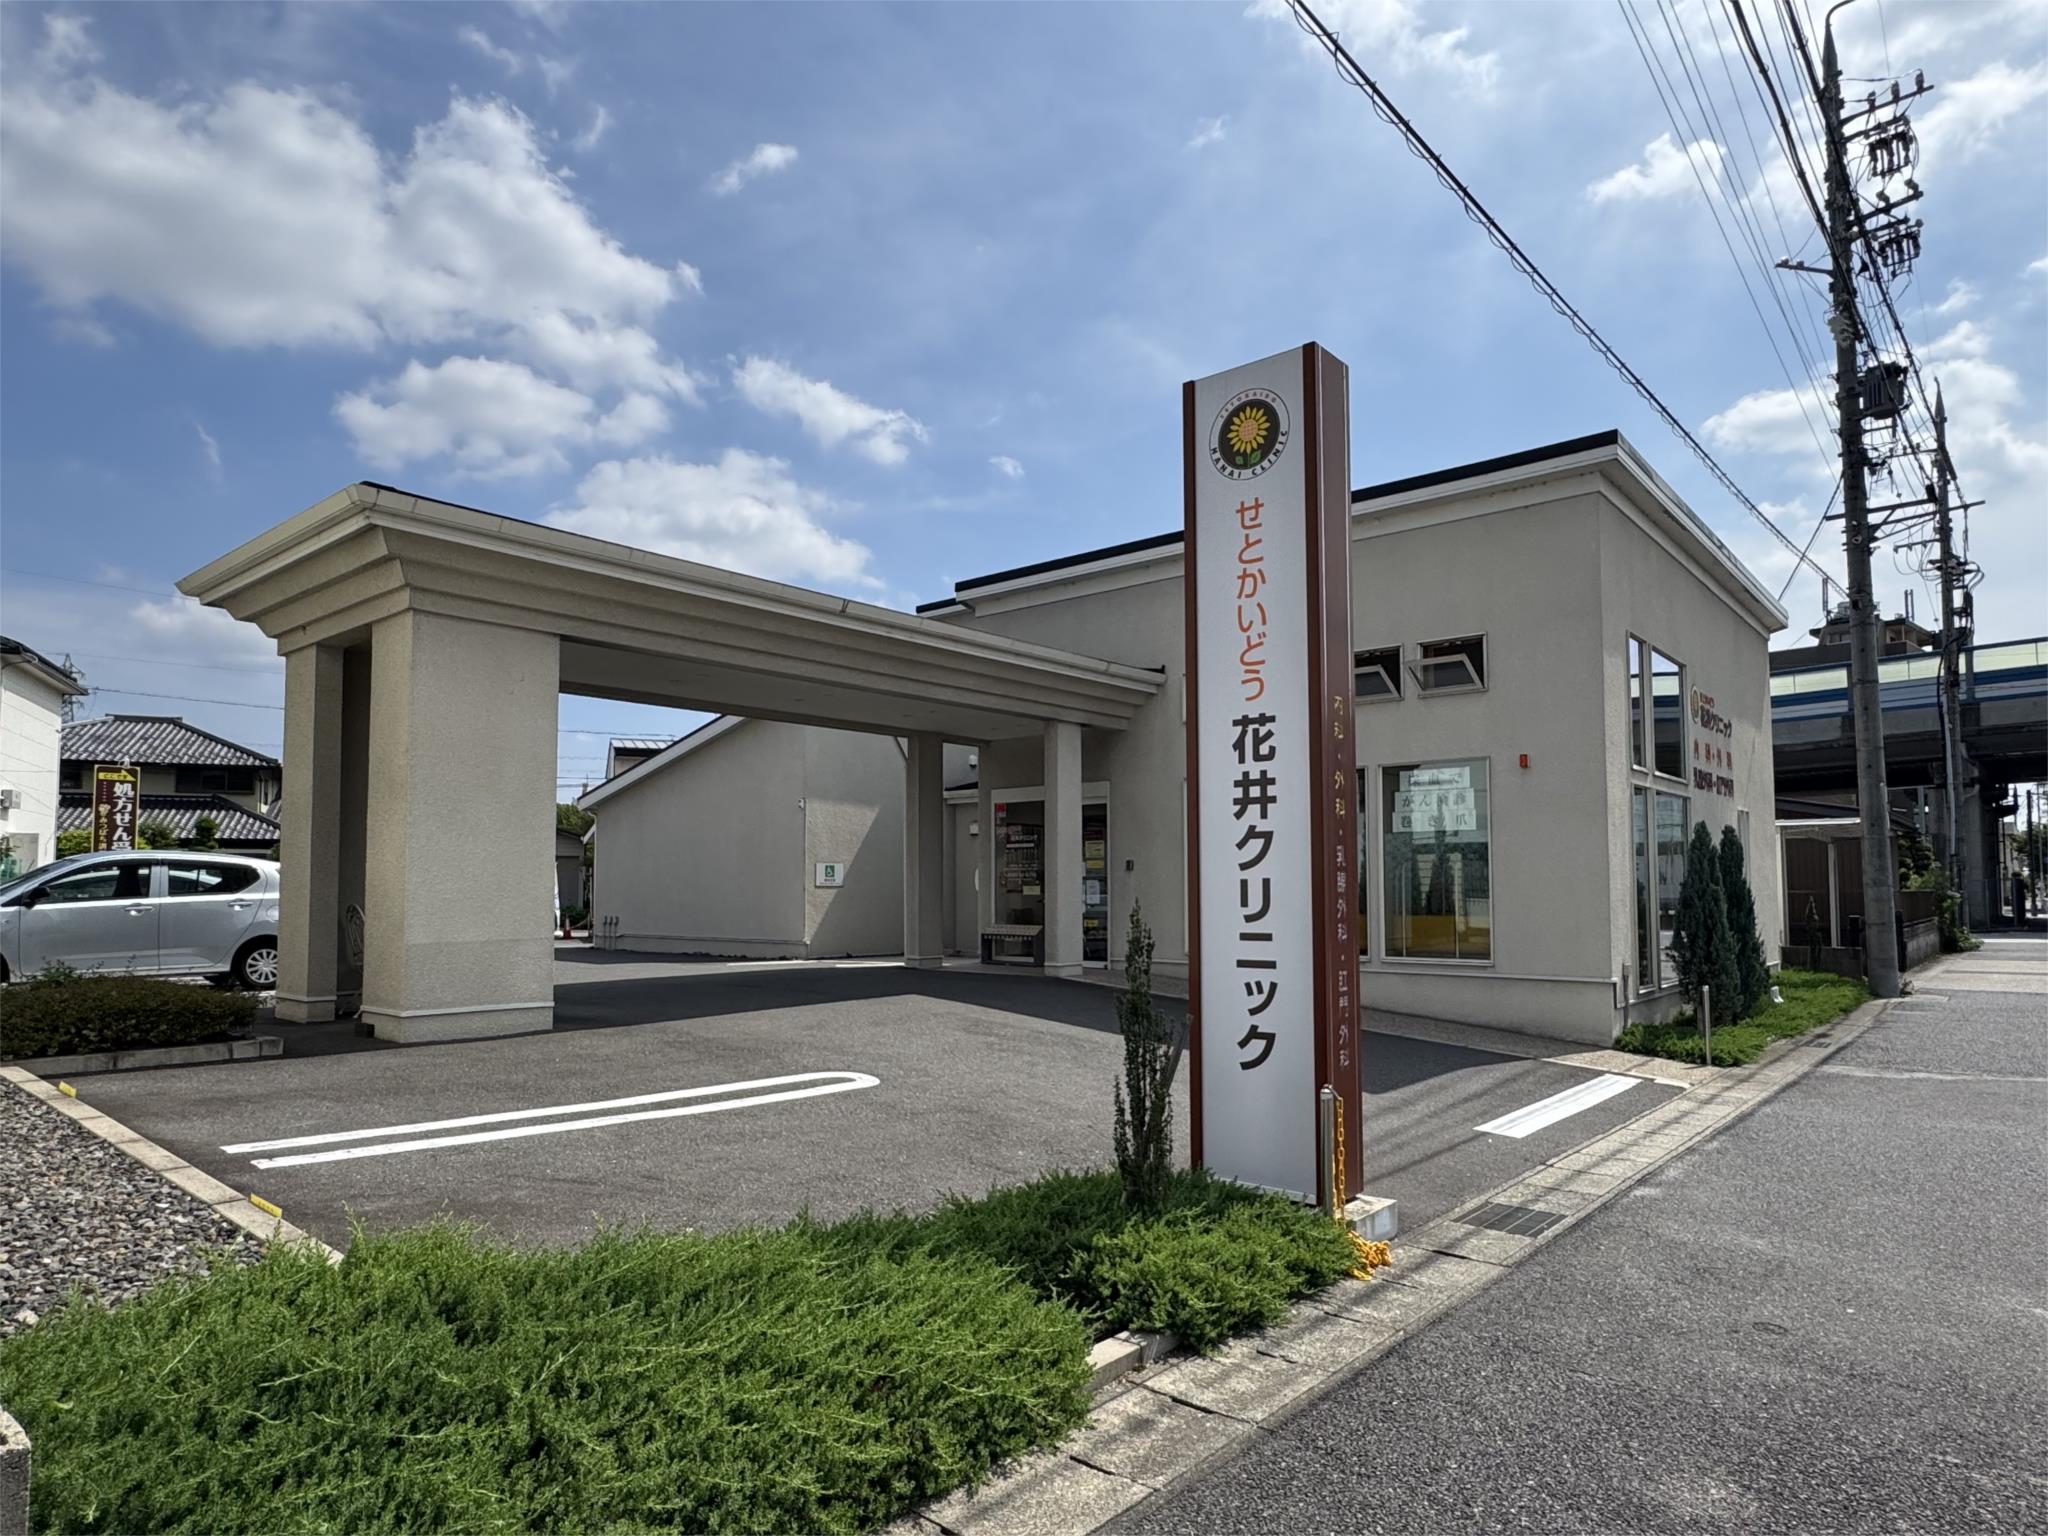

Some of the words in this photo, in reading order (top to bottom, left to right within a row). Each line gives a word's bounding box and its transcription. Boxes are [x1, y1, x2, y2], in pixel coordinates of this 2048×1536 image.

[1210, 446, 1243, 479] HANAI
[1251, 430, 1288, 477] CLINIC
[1235, 496, 1268, 702] せとかいどう
[1231, 712, 1279, 1071] 花井クリニック
